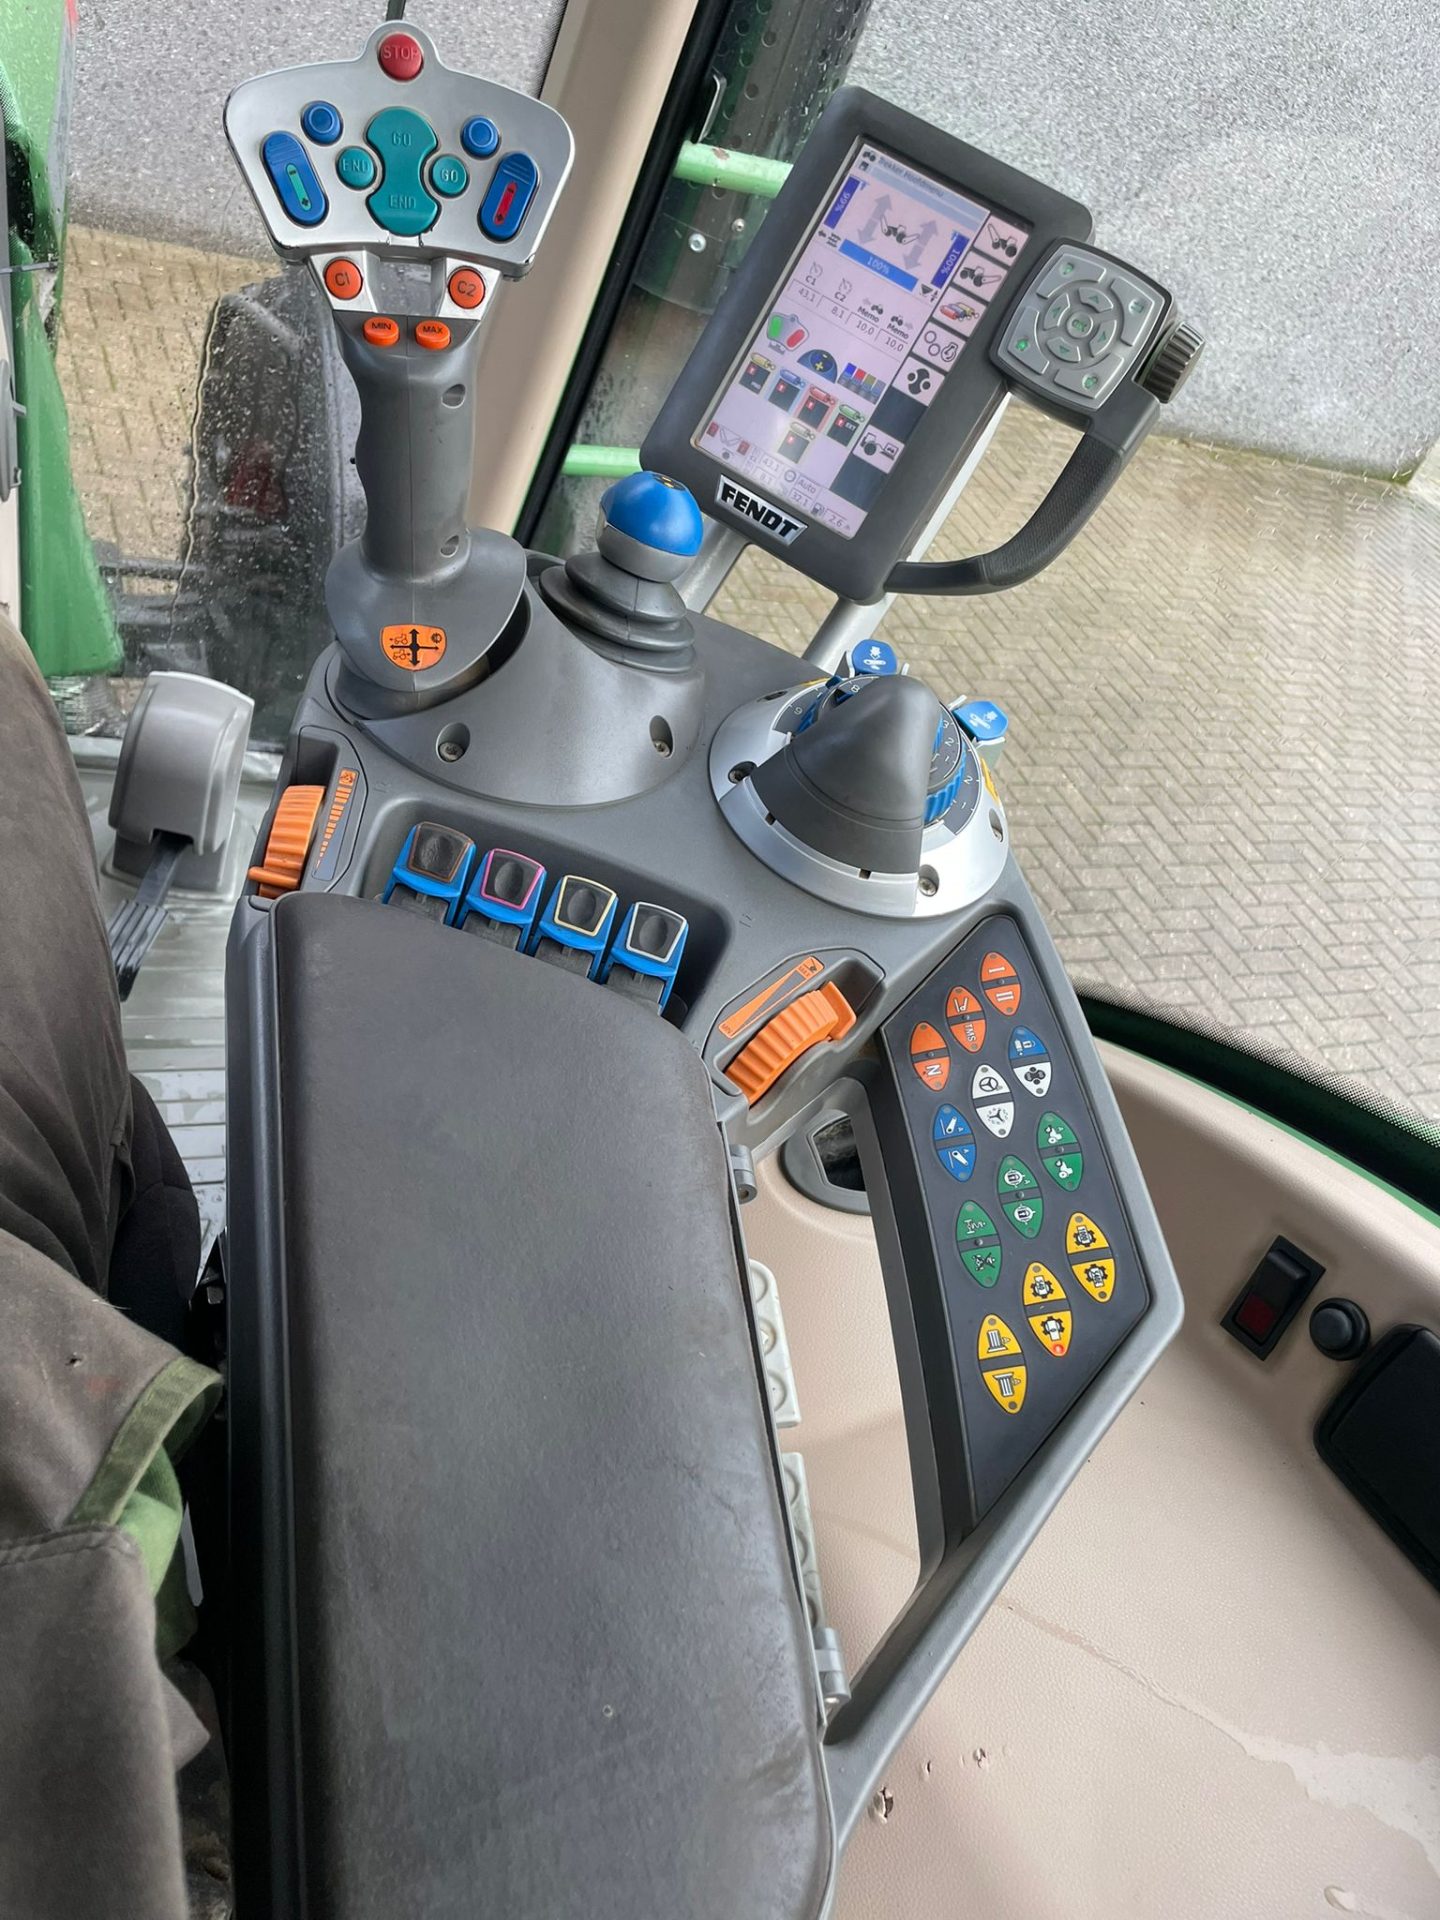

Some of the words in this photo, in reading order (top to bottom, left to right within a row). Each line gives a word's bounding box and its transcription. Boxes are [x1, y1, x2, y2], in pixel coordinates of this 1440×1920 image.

[382, 44, 420, 60] STOP
[391, 131, 413, 147] GO
[342, 158, 371, 173] END
[441, 169, 459, 183] GO
[388, 194, 417, 209] END
[834, 192, 851, 213] 99%
[866, 256, 891, 276] 100%
[940, 249, 960, 276] 100%
[805, 275, 817, 286] C1
[457, 280, 477, 297] C2
[798, 287, 816, 303] 43,1
[834, 291, 847, 303] C2
[830, 306, 846, 320] 8,1
[857, 306, 880, 323] Memo
[371, 321, 392, 331] MIN
[422, 324, 443, 335] MAX
[855, 320, 875, 336] 10,0
[887, 323, 910, 340] Memo
[885, 336, 905, 352] 10,0
[798, 479, 817, 494] Auto
[721, 483, 798, 537] FENDT
[828, 515, 842, 527] 2.6
[850, 685, 860, 693] 8
[942, 720, 950, 729] 3
[944, 737, 955, 747] 2
[963, 776, 973, 784] 2
[965, 1023, 977, 1042] TMS
[926, 1064, 942, 1077] N
